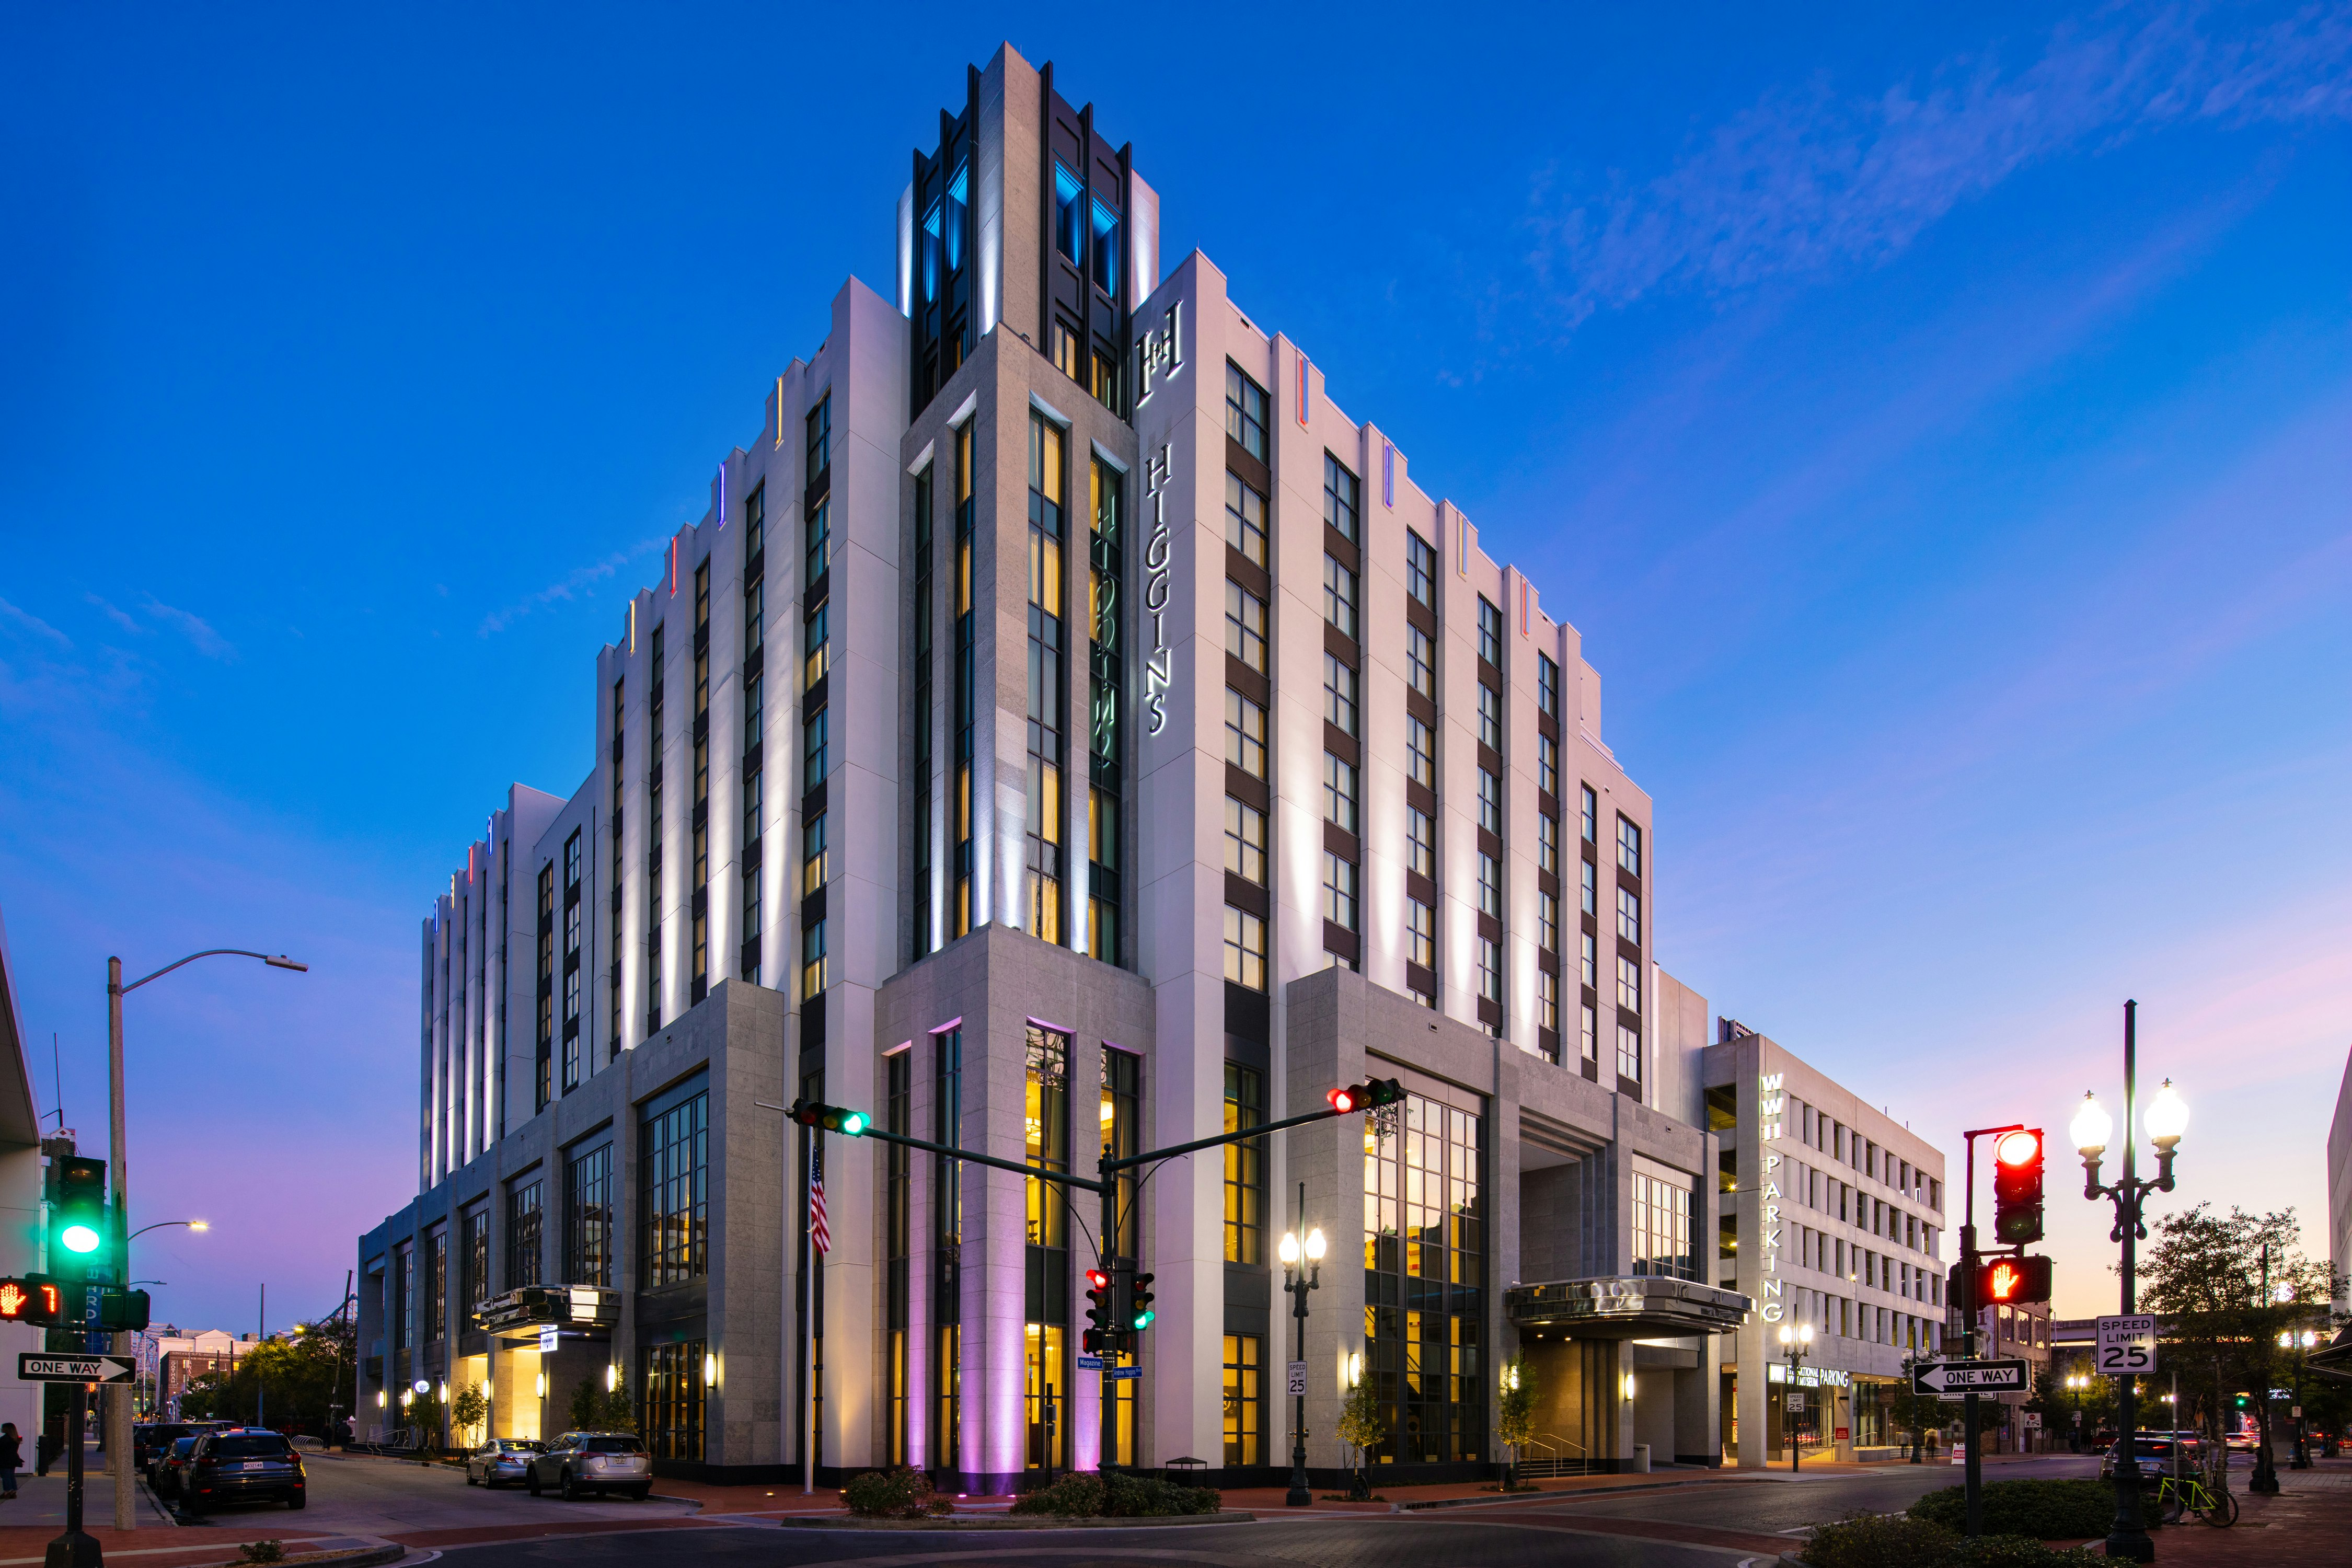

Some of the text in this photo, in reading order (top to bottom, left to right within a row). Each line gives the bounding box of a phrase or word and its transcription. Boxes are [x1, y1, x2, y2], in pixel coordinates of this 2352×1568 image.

[1145, 442, 1172, 735] HIGGINS
[1762, 1156, 1784, 1322] PARKING
[2102, 1320, 2151, 1330] SPEED
[2107, 1333, 2145, 1343] LIMIT
[1080, 1359, 1101, 1367] Magazine
[2103, 1346, 2148, 1368] 25
[31, 1362, 101, 1374] ONE WAY
[1125, 1369, 1136, 1377] Higgins
[1800, 1377, 1818, 1387] MUSEUM
[1820, 1368, 1849, 1388] PARKING
[1946, 1369, 2013, 1384] ONE WAY
[1290, 1380, 1304, 1392] 25
